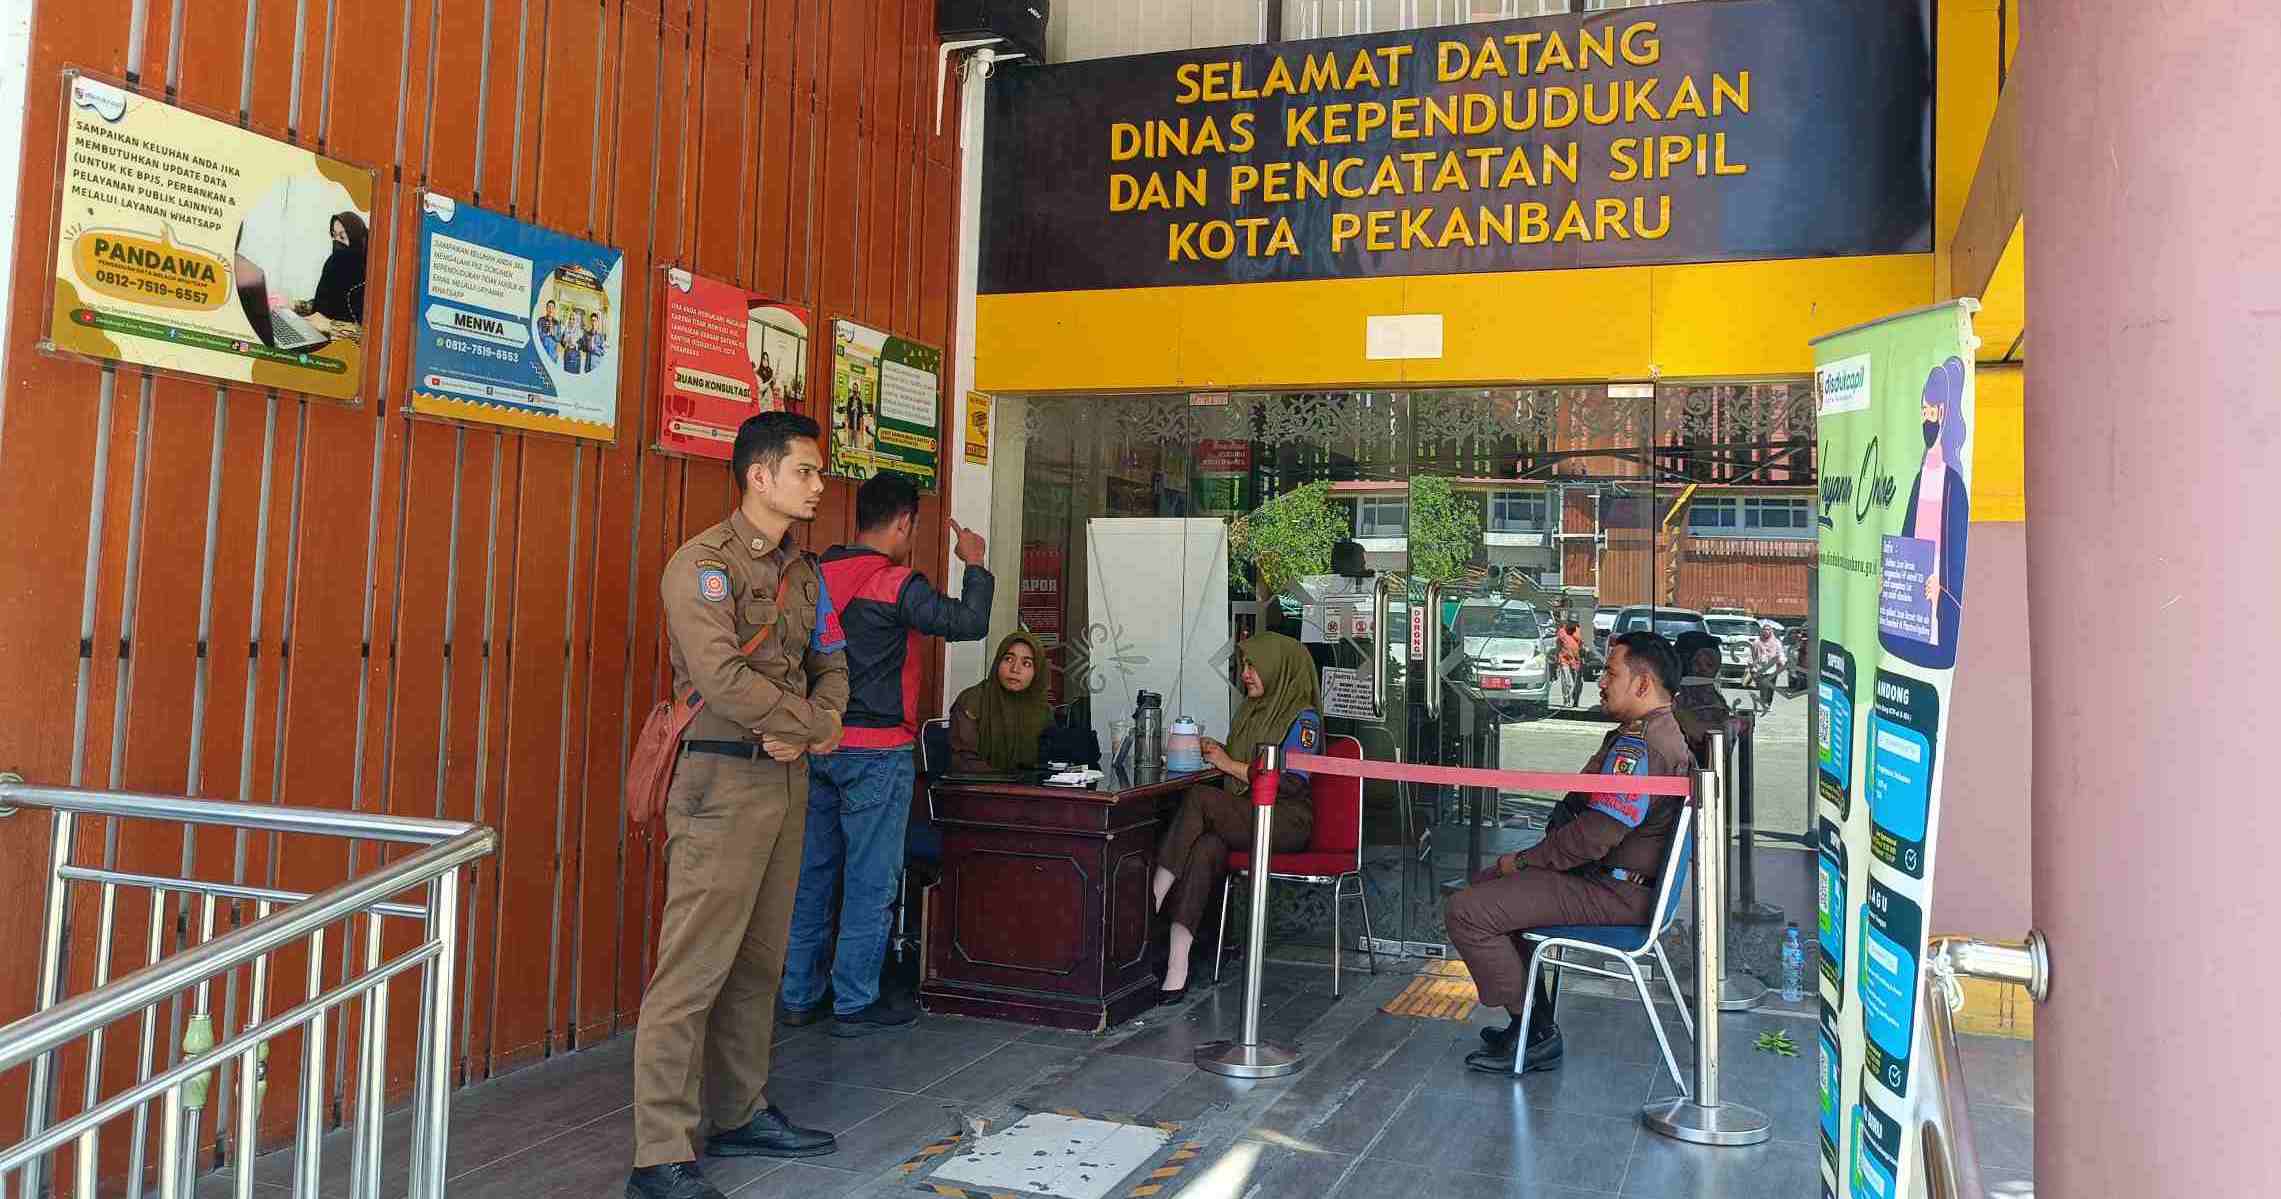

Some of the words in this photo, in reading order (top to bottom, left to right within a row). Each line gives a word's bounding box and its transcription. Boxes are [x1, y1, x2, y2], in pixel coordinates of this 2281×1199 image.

[1175, 45, 1412, 104] SELAMAT
[1438, 22, 1660, 82] DATANG
[1111, 113, 1255, 162] DINAS
[1286, 71, 1749, 148] KEPENDUDUKAN
[75, 137, 159, 169] MEMBUTUHKAN
[162, 162, 201, 181] UPDATE
[203, 174, 227, 188] DATA
[76, 120, 140, 148] SAMPAIKAN
[142, 140, 189, 162] KELUHAN
[192, 155, 218, 171] ANDA
[221, 165, 240, 177] JIKA
[1110, 169, 1207, 212] DAN
[1230, 142, 1578, 206] PENCATATAN
[1608, 132, 1749, 182] SIPIL
[73, 169, 135, 194] PELAYANAN
[138, 187, 176, 204] PUBLIK
[179, 196, 223, 218] LAINNYA)
[74, 151, 117, 172] (UNTUK
[120, 167, 133, 177] KE
[168, 180, 226, 203] PERBANKAN
[229, 198, 236, 206] &
[72, 185, 117, 205] MELALUI
[121, 198, 167, 218] LAYANAN
[170, 213, 222, 231] WHATSAPP
[1168, 217, 1297, 262] KOTA
[1331, 195, 1672, 253] PEKANBARU
[94, 238, 216, 283] PANDAWA
[96, 270, 208, 304] 0812-7519-6557
[454, 313, 504, 335] MENWA
[677, 373, 704, 388] RUANG
[705, 381, 750, 398] KONSULTASI
[1825, 366, 1864, 394] disdukcapil
